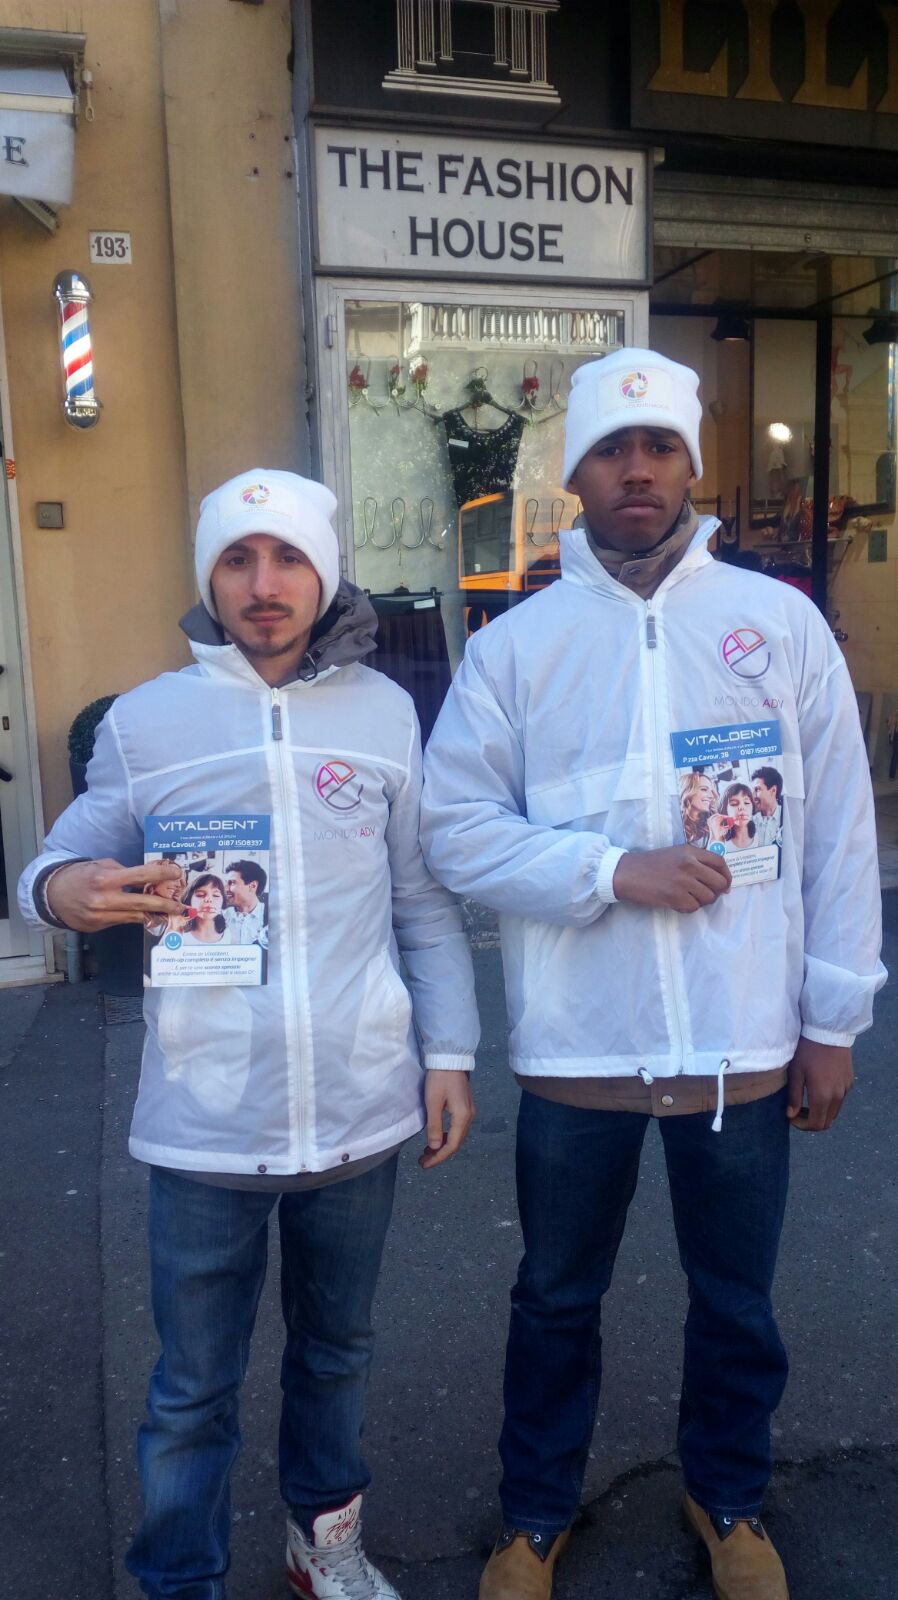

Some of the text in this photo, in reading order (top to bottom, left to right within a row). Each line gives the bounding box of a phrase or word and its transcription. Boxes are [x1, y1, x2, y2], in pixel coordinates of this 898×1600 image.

[327, 144, 634, 205] THE FASHION
[95, 236, 126, 258] 193
[409, 216, 564, 264] HOUSE
[685, 728, 771, 746] VITALDENT
[158, 820, 258, 832] VITALDENT
[197, 840, 207, 848] 28
